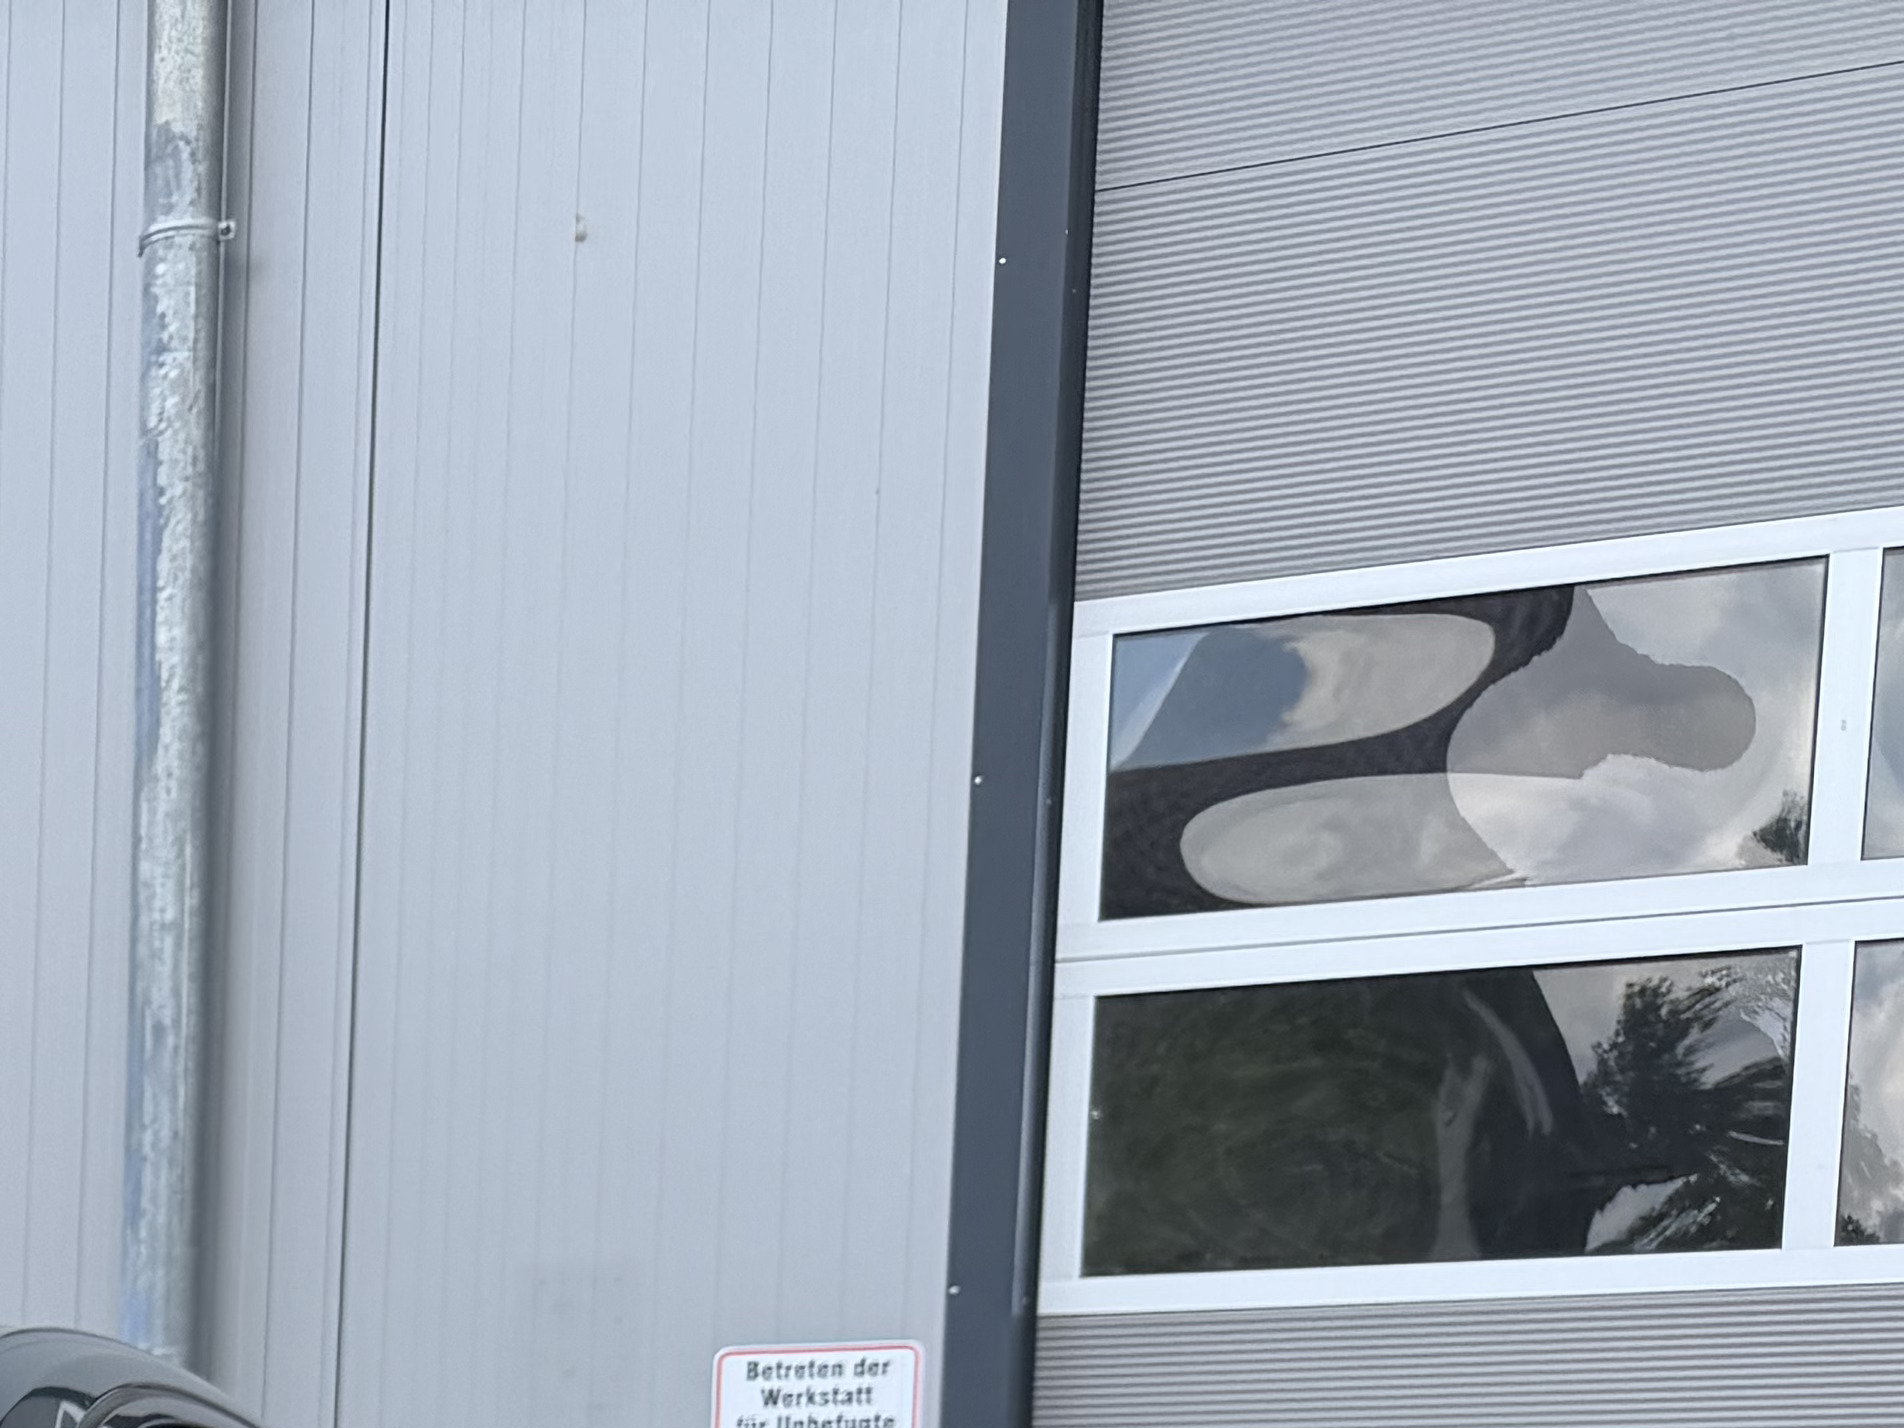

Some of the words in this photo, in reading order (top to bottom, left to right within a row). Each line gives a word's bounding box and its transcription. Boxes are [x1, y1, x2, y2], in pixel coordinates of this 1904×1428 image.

[746, 1361, 843, 1381] Betreten
[853, 1358, 891, 1377] der
[761, 1386, 874, 1408] Werkstatt
